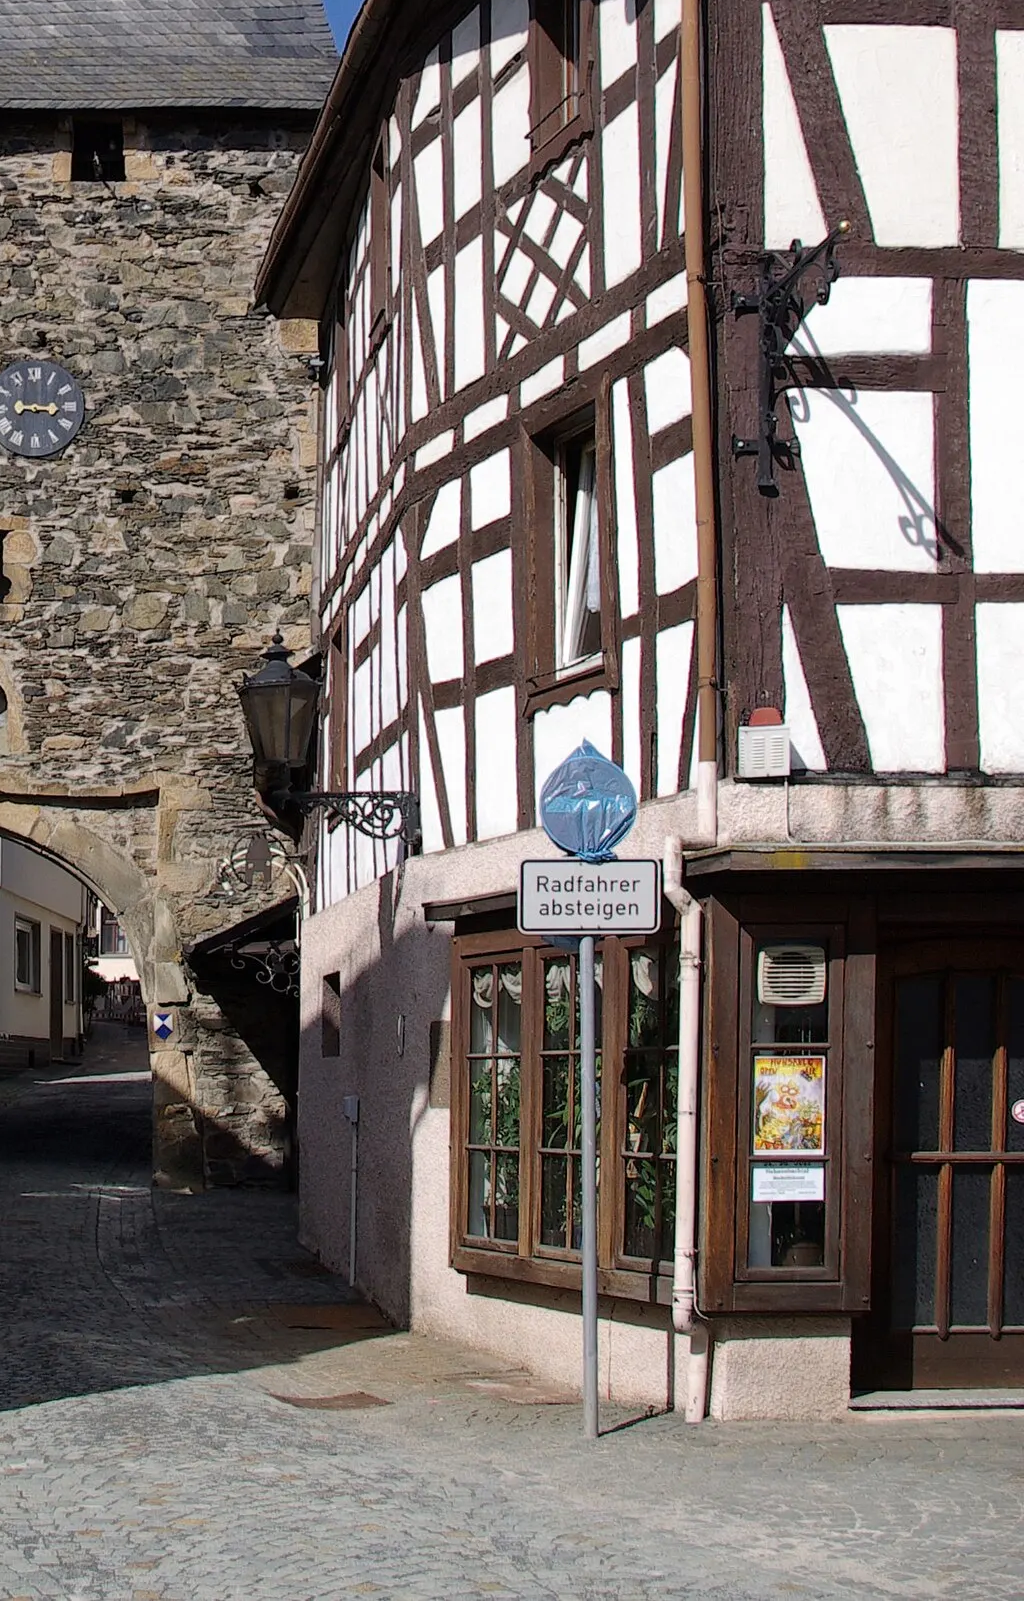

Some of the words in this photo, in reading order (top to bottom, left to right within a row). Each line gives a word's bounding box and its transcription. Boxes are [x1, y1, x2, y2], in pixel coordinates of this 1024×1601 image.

[28, 368, 41, 382] XII
[47, 372, 56, 385] I
[57, 384, 72, 395] II
[62, 401, 76, 411] III
[47, 429, 59, 443] V
[536, 876, 641, 893] Radfahrer
[539, 899, 639, 920] absteigen
